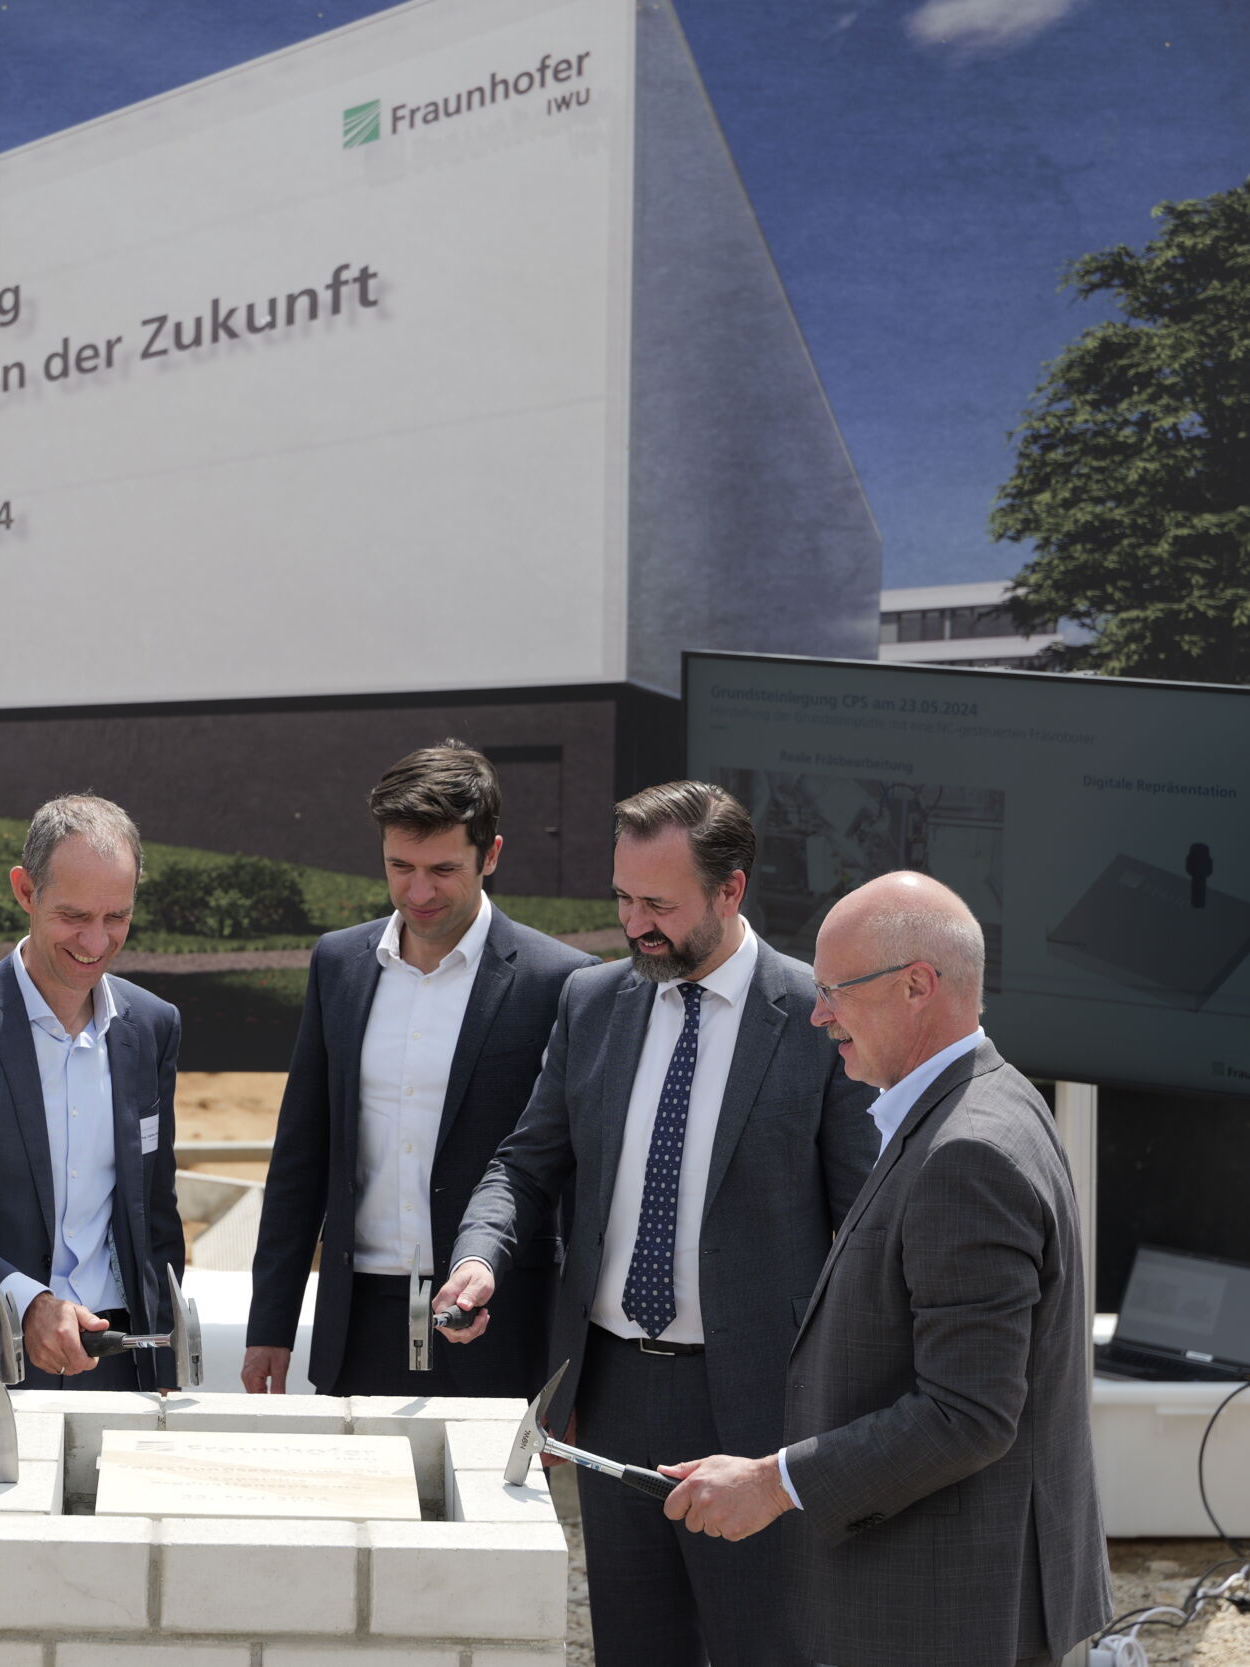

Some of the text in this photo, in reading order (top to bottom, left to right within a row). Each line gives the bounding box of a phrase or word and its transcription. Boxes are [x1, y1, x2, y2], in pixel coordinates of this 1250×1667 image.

[391, 51, 591, 135] Fraunhofer
[547, 87, 591, 116] IWU
[43, 334, 124, 382] der
[140, 263, 379, 361] Zukunft
[710, 684, 978, 717] Grundsteinlegung CPS am 23.05.2024
[779, 749, 914, 775] Reale Fräsbearbeitung
[1082, 773, 1238, 799] Digitale Repräsentation
